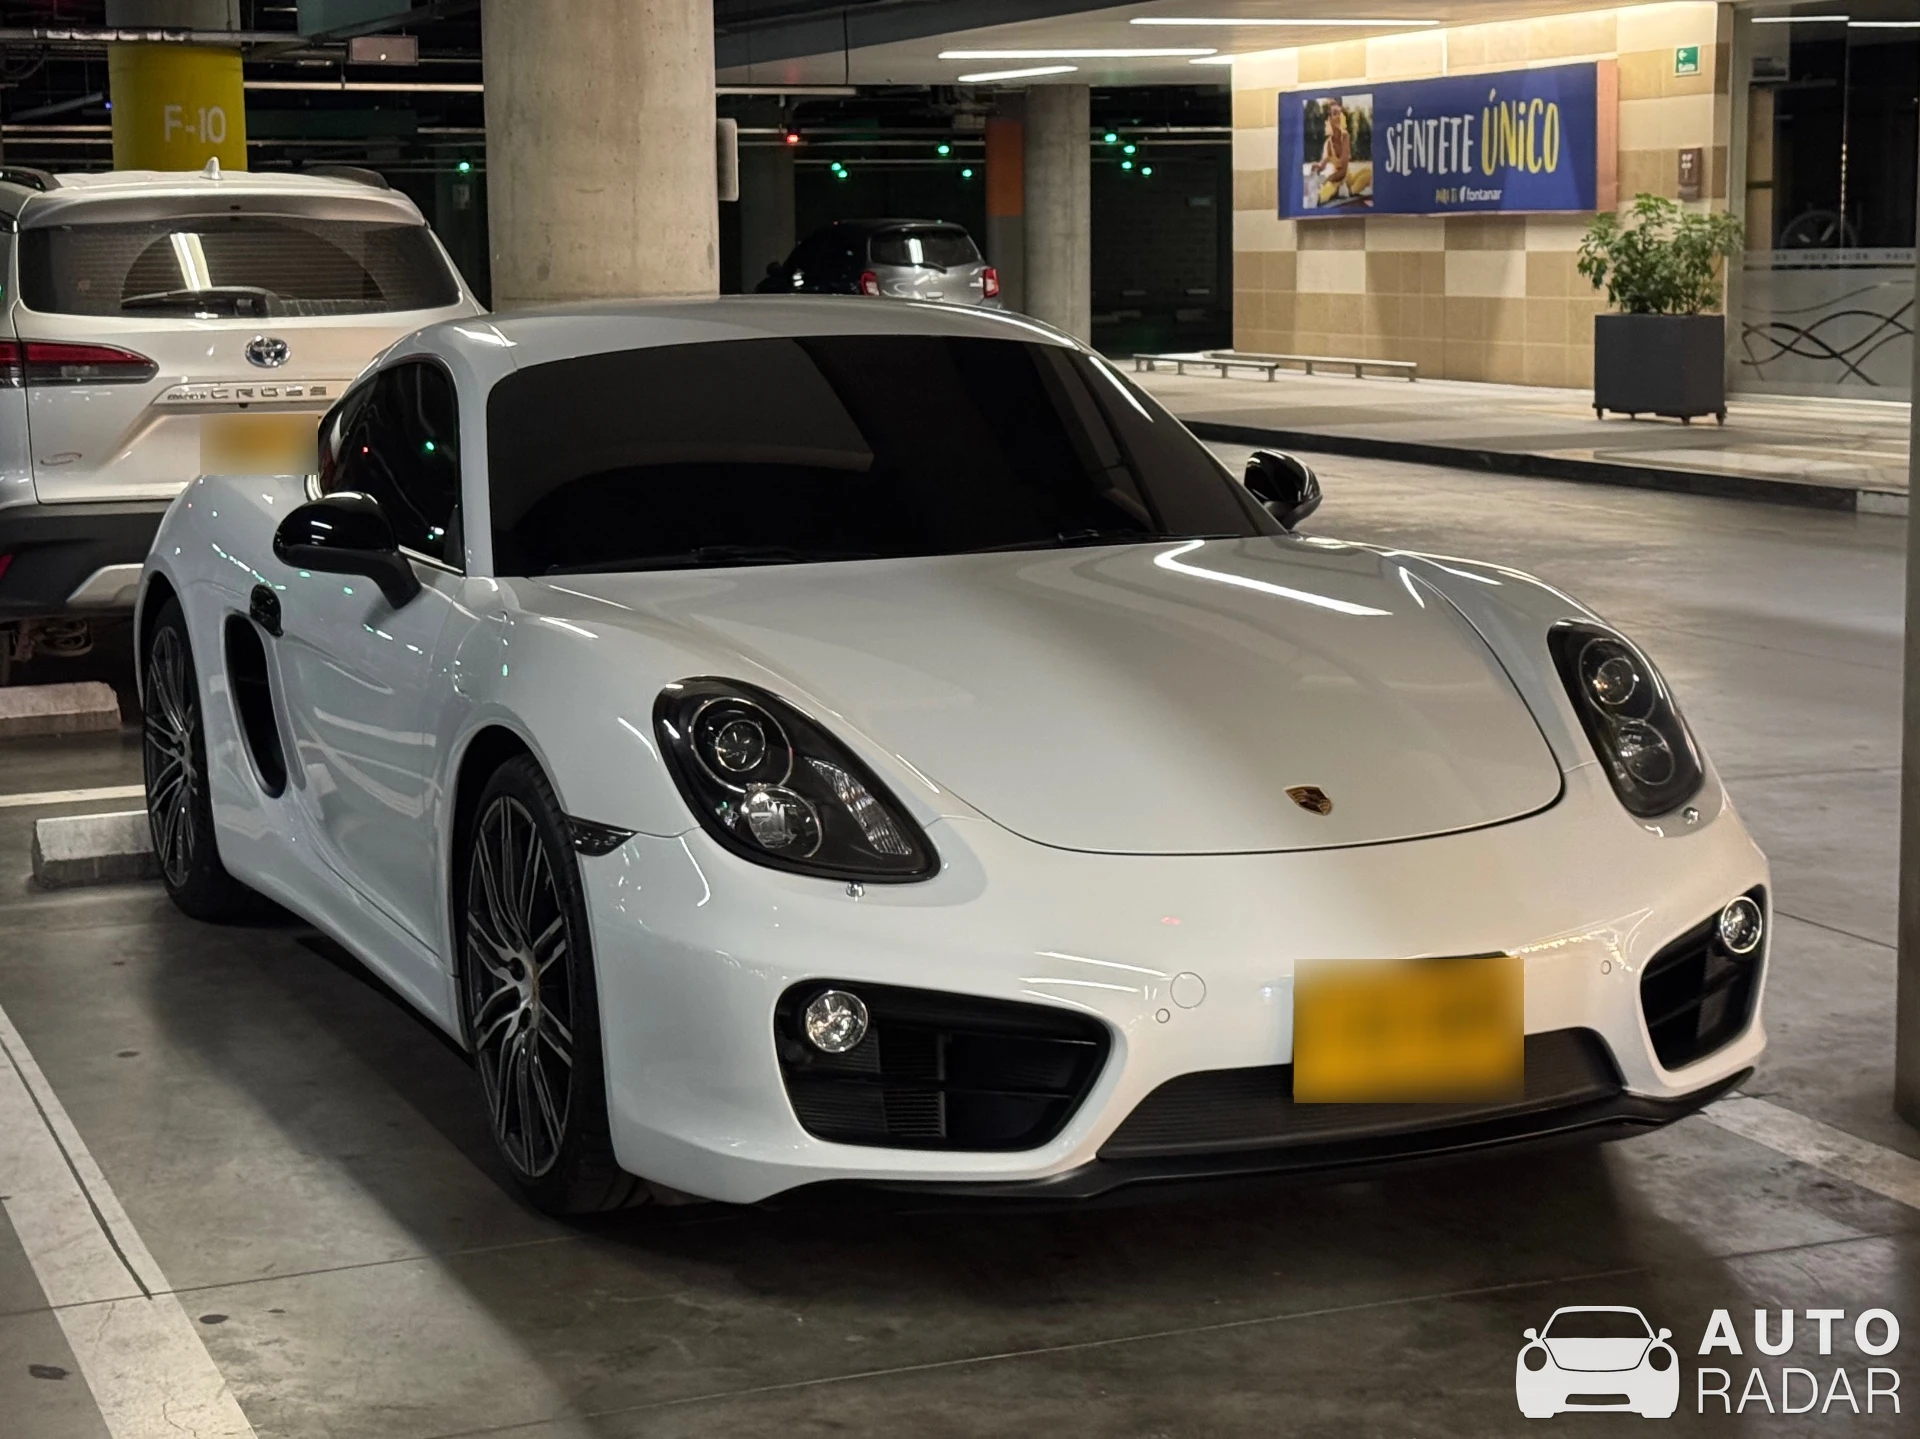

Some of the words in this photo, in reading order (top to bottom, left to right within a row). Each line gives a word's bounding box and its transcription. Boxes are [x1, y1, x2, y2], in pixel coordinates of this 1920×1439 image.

[164, 104, 226, 144] F-10
[1466, 187, 1502, 202] fontanar
[210, 385, 327, 400] CROSS
